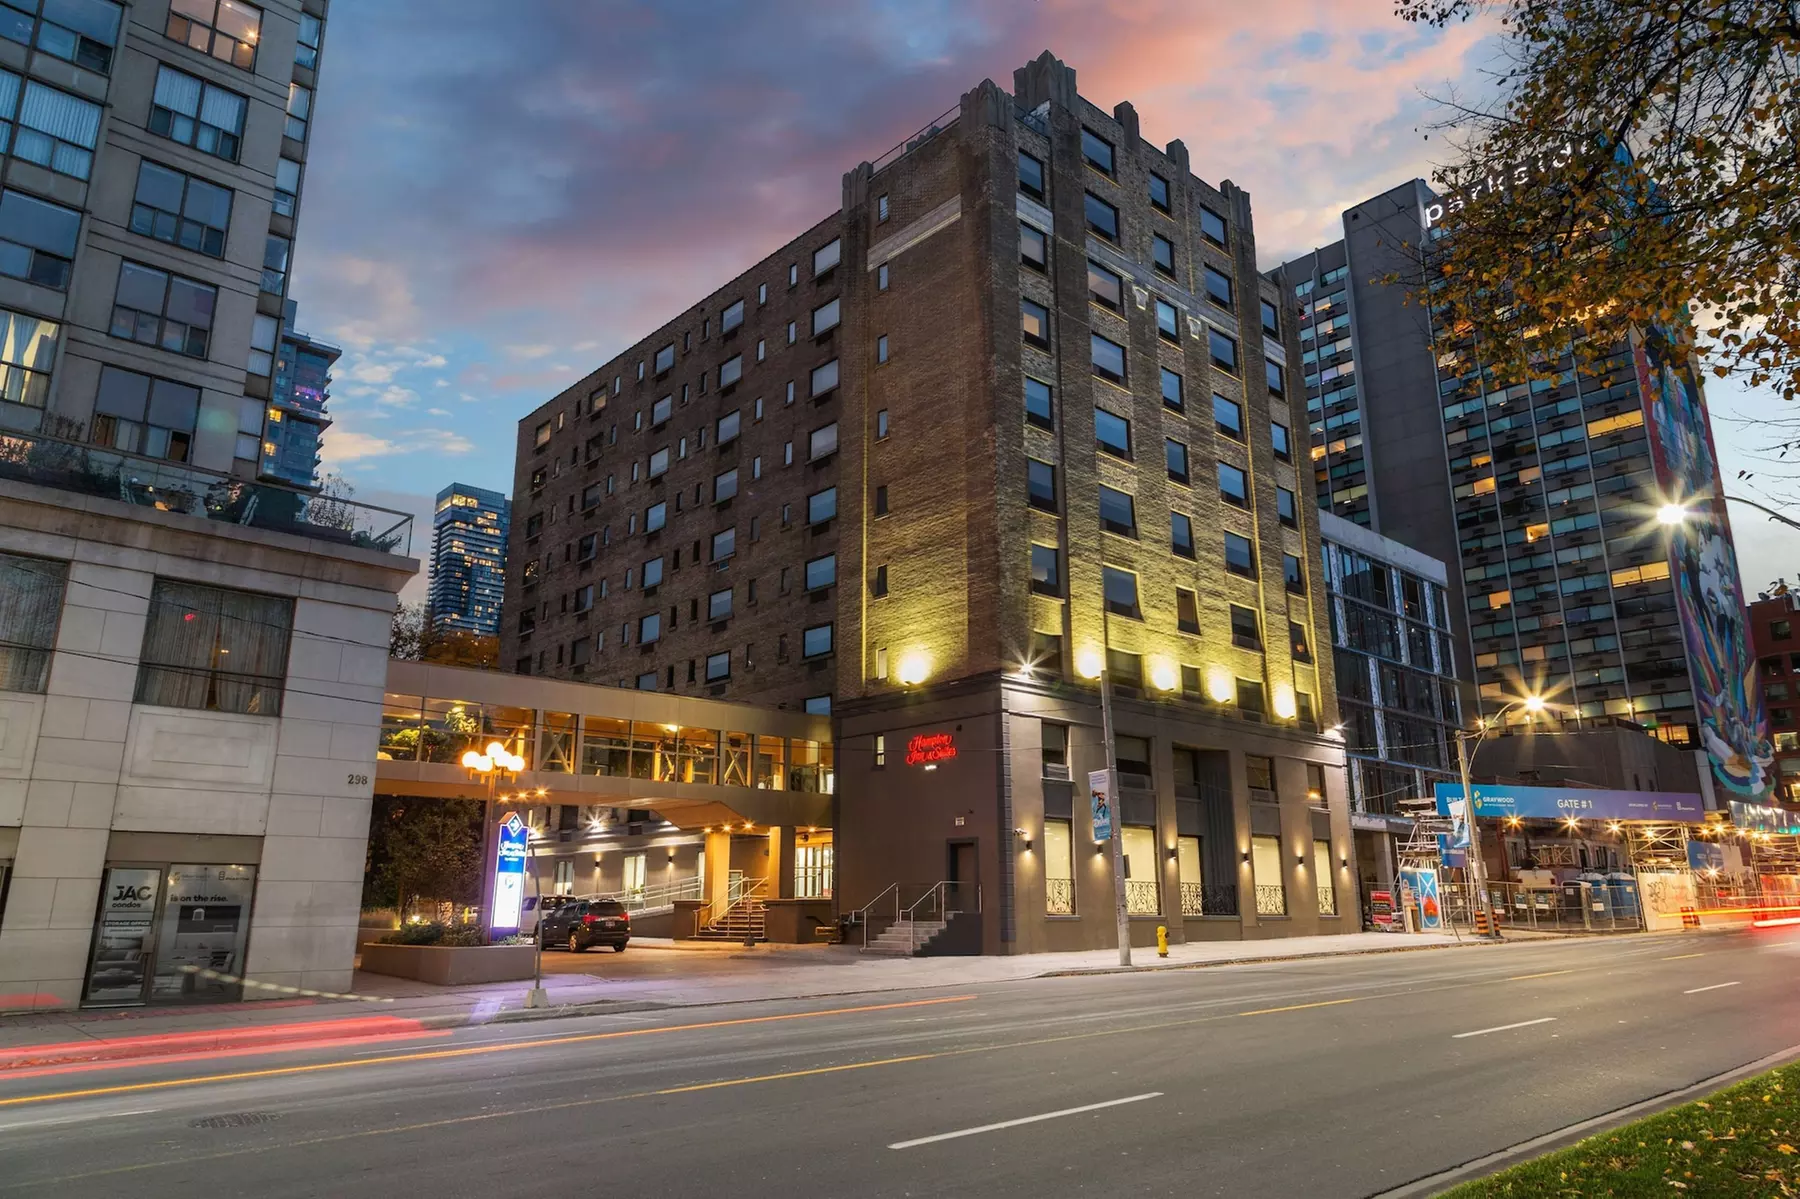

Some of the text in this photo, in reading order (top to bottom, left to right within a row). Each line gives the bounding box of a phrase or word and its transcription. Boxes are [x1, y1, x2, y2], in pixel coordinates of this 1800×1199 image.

[908, 734, 953, 752] Hampton
[347, 773, 368, 786] 298
[1482, 796, 1515, 804] GRAYWOOD
[1557, 799, 1580, 809] GATE
[113, 885, 153, 901] JAC
[170, 894, 178, 902] is
[193, 894, 209, 902] the
[210, 894, 228, 902] rise.
